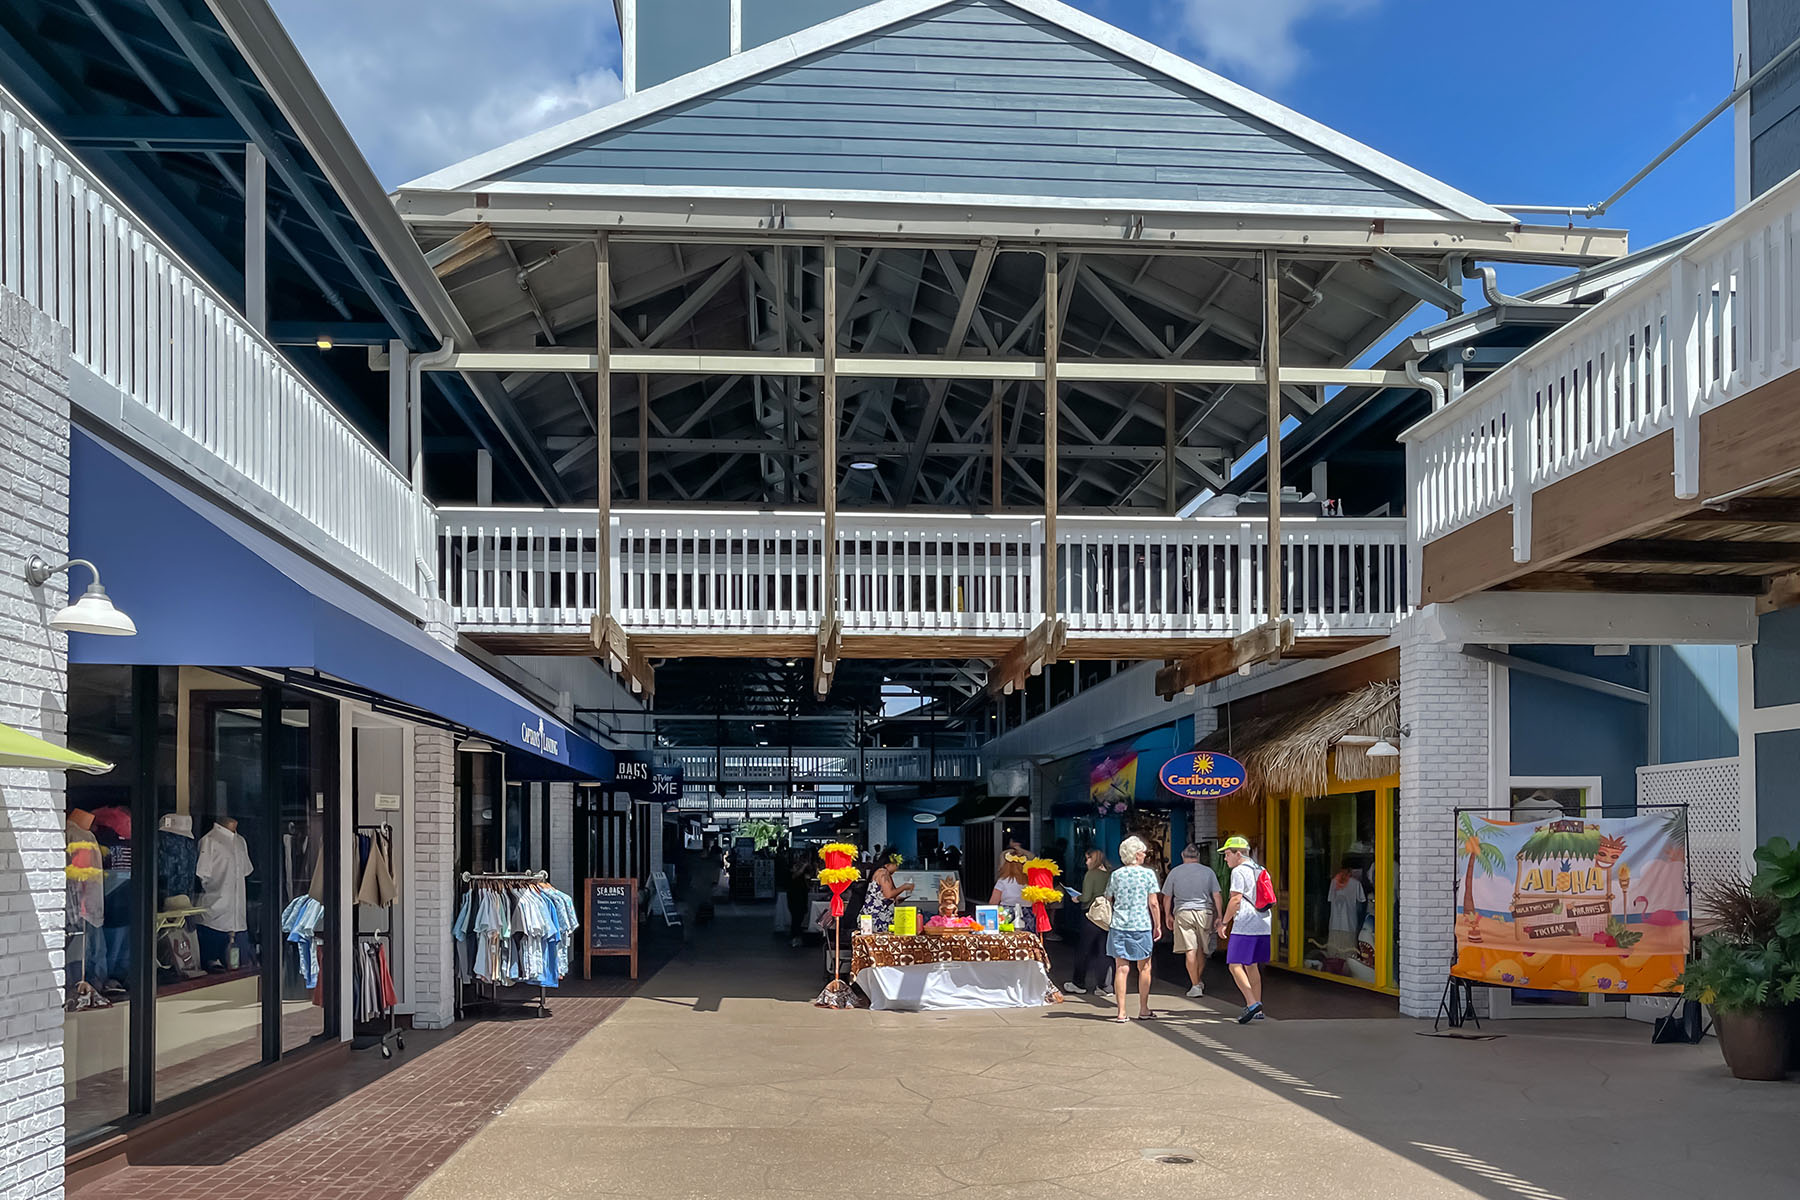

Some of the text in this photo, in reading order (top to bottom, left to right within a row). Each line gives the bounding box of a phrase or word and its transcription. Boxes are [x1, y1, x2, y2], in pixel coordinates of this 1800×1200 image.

[619, 762, 647, 780] BAGS
[1168, 774, 1239, 788] Caribongo
[1521, 867, 1604, 894] ALOHA
[596, 886, 608, 897] SEA
[1534, 924, 1566, 937] TIKI BAR
